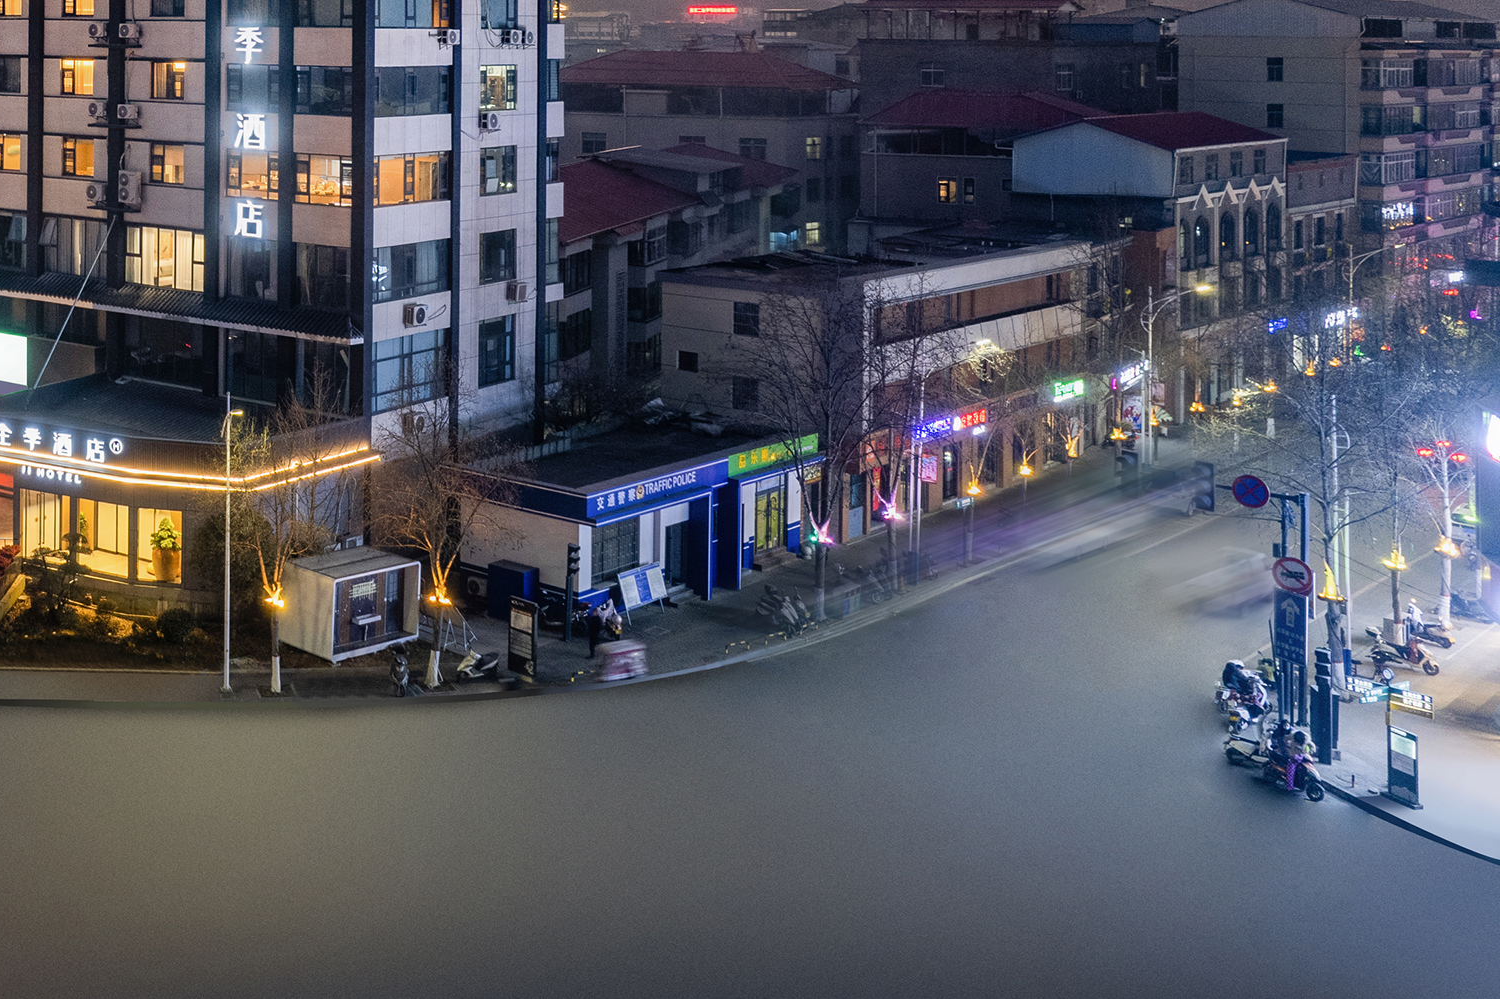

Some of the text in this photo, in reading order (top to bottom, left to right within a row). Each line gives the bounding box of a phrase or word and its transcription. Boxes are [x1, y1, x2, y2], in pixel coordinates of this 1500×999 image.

[36, 468, 82, 485] HOTEL
[645, 471, 697, 495] TRAFFIC POLICE
[596, 488, 636, 511] 交通警察
